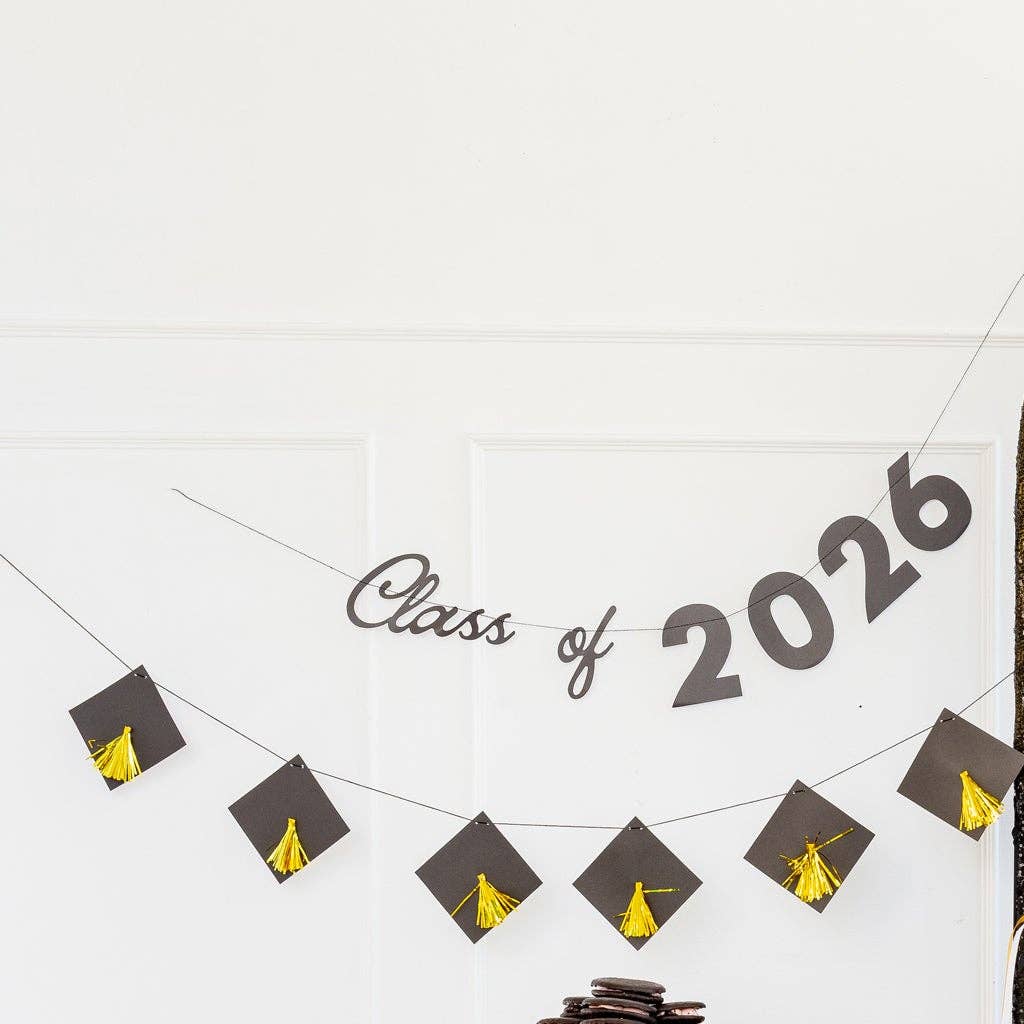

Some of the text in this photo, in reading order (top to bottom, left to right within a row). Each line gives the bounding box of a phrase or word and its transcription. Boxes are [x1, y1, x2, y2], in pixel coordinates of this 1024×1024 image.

[346, 452, 973, 709] Class of 2026
